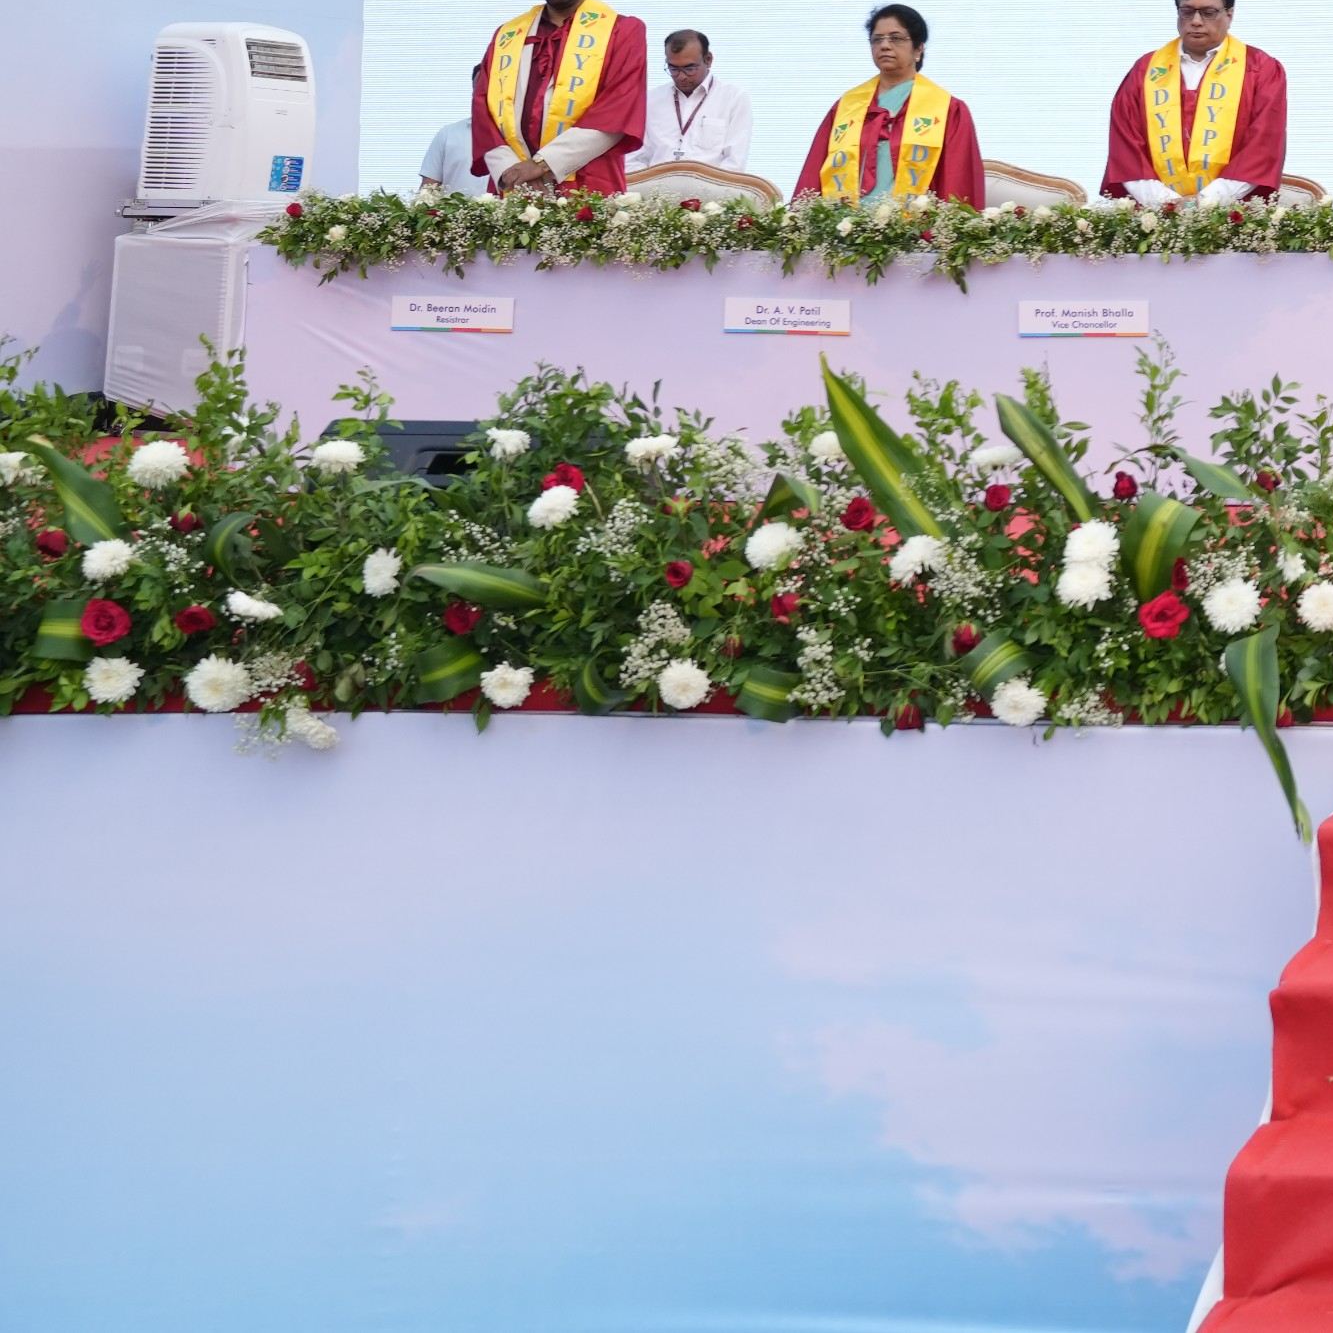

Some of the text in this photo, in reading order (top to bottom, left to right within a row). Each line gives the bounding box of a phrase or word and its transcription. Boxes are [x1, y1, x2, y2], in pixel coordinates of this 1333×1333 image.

[410, 304, 496, 313] Dr. Beeran Moidin
[756, 306, 769, 314] Dr.
[774, 306, 783, 314] A.
[800, 307, 821, 315] Patil
[1035, 308, 1134, 318] Prof. Manish Bhalla
[745, 317, 831, 328] Dean Of Engineering
[1072, 321, 1117, 329] Chancellor
